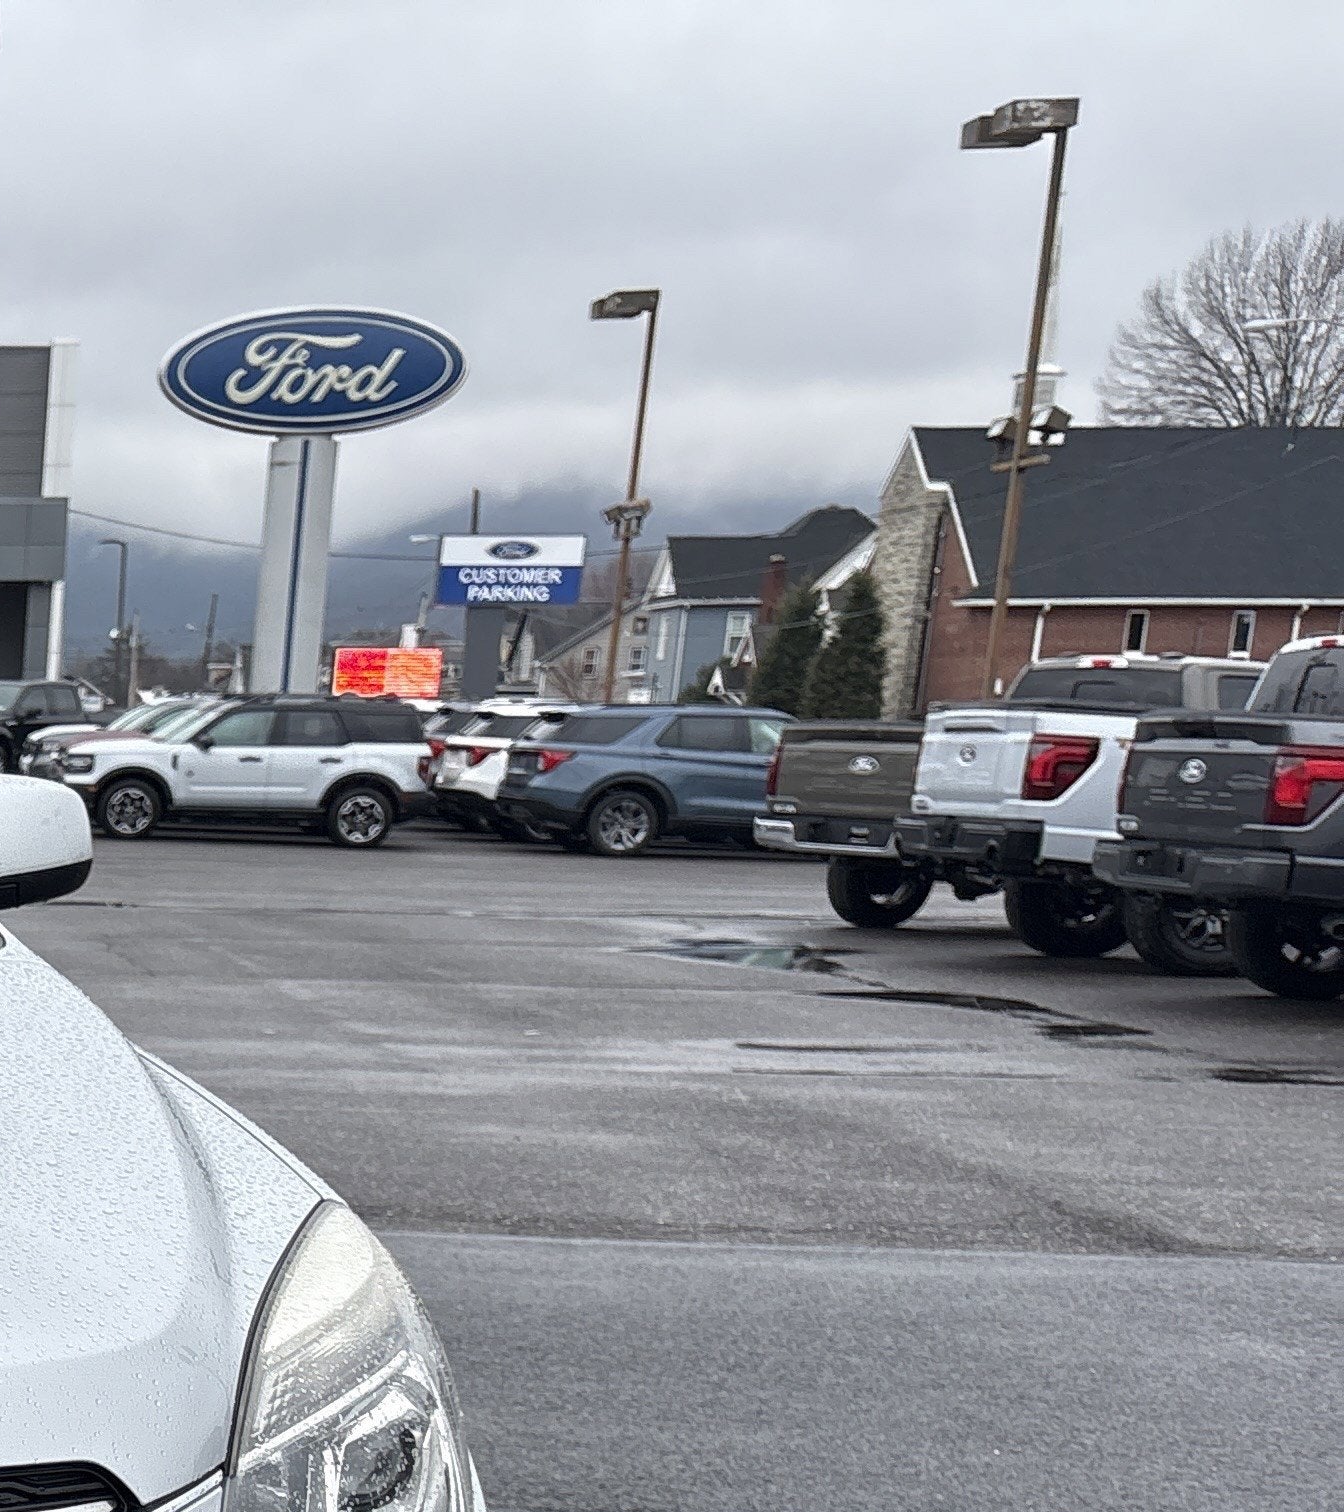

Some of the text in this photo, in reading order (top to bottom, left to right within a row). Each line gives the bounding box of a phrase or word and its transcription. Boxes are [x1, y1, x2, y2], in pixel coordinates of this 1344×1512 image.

[224, 331, 407, 405] Ford
[458, 567, 563, 585] CUSTOMER
[466, 585, 551, 602] PARKING
